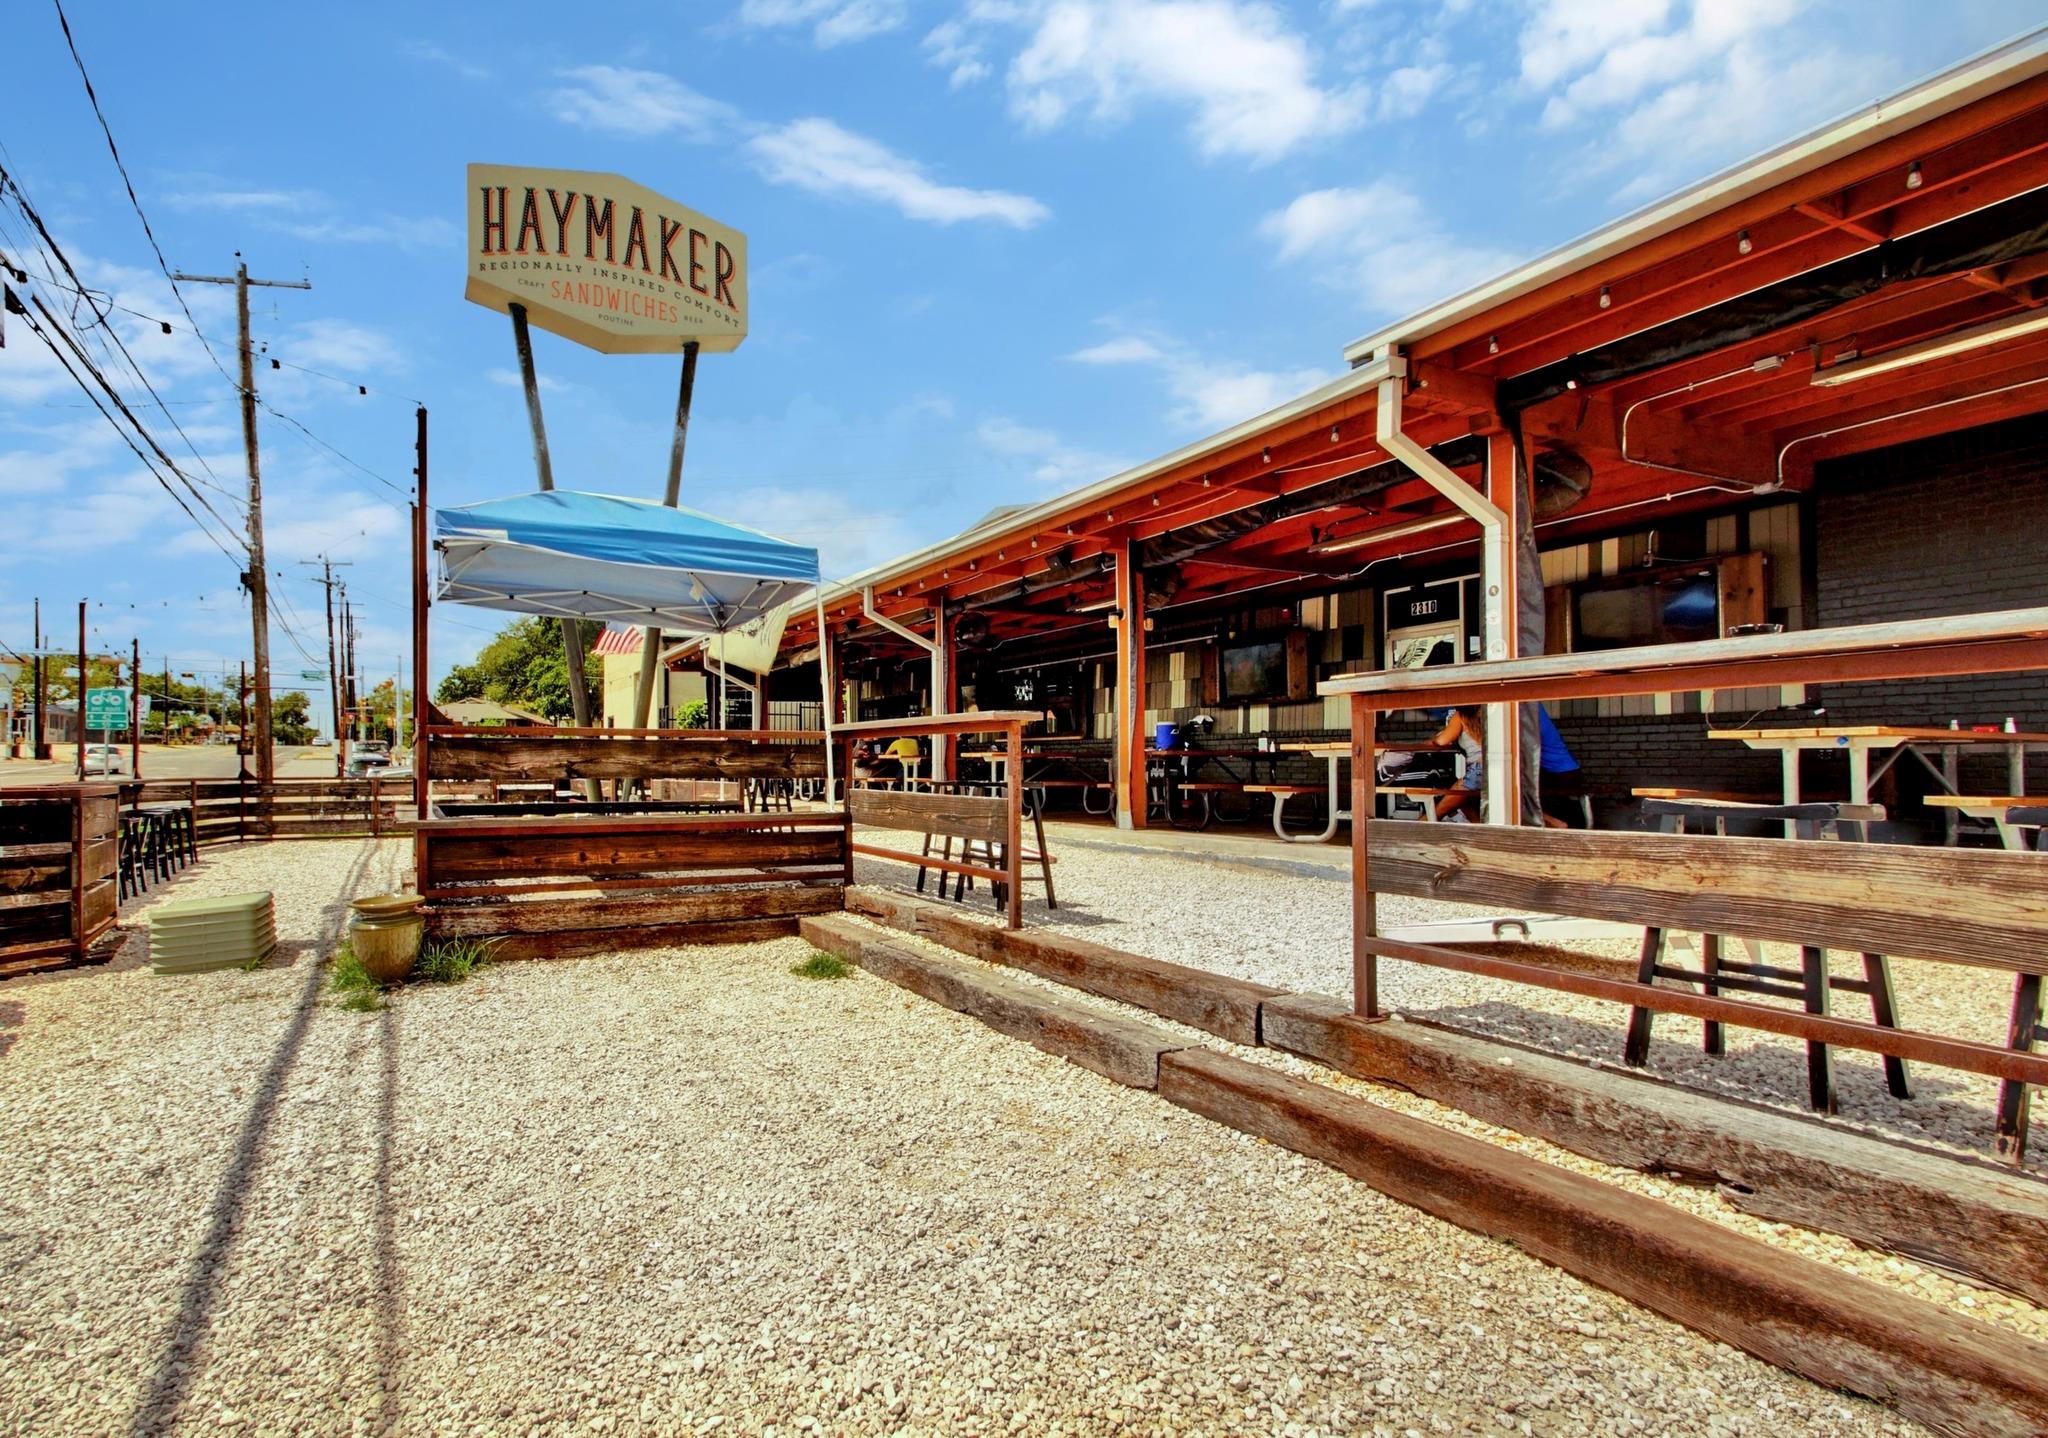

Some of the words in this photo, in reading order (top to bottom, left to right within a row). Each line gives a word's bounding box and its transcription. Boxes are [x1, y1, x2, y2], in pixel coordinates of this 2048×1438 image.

[480, 186, 739, 313] HAYMAKER
[479, 261, 583, 273] REGIONALLY
[592, 267, 666, 293] INSPIRED
[673, 291, 739, 328] COMFORT
[517, 278, 546, 290] CRAFT
[551, 280, 679, 324] SANDWICHES
[597, 313, 634, 327] POUTINE
[1412, 601, 1436, 615] 2310
